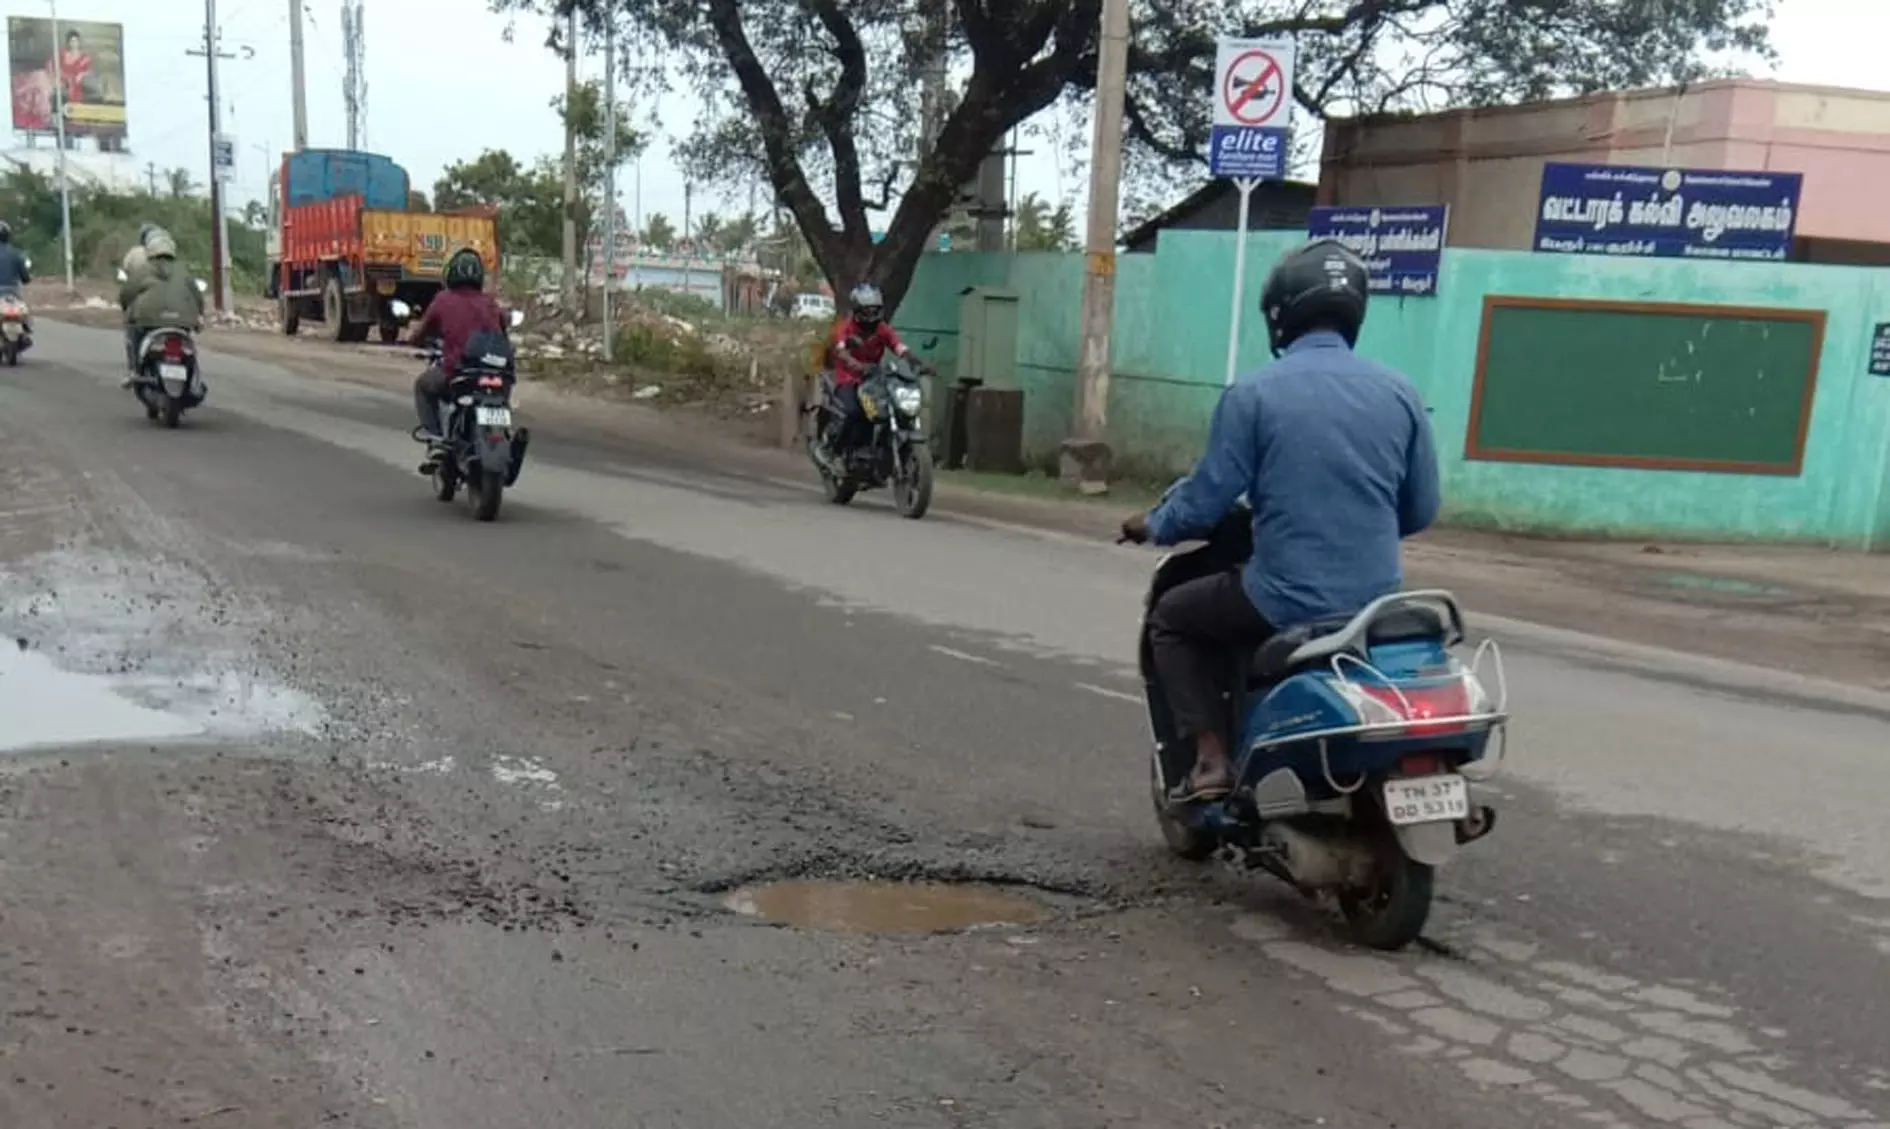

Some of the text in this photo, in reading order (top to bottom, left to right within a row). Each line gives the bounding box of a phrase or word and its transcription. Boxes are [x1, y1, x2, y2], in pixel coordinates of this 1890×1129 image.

[1221, 129, 1278, 151] elite
[1628, 191, 1684, 226] கல்வி
[1686, 197, 1792, 242] அலுவலகம்
[1401, 781, 1451, 799] TN 37
